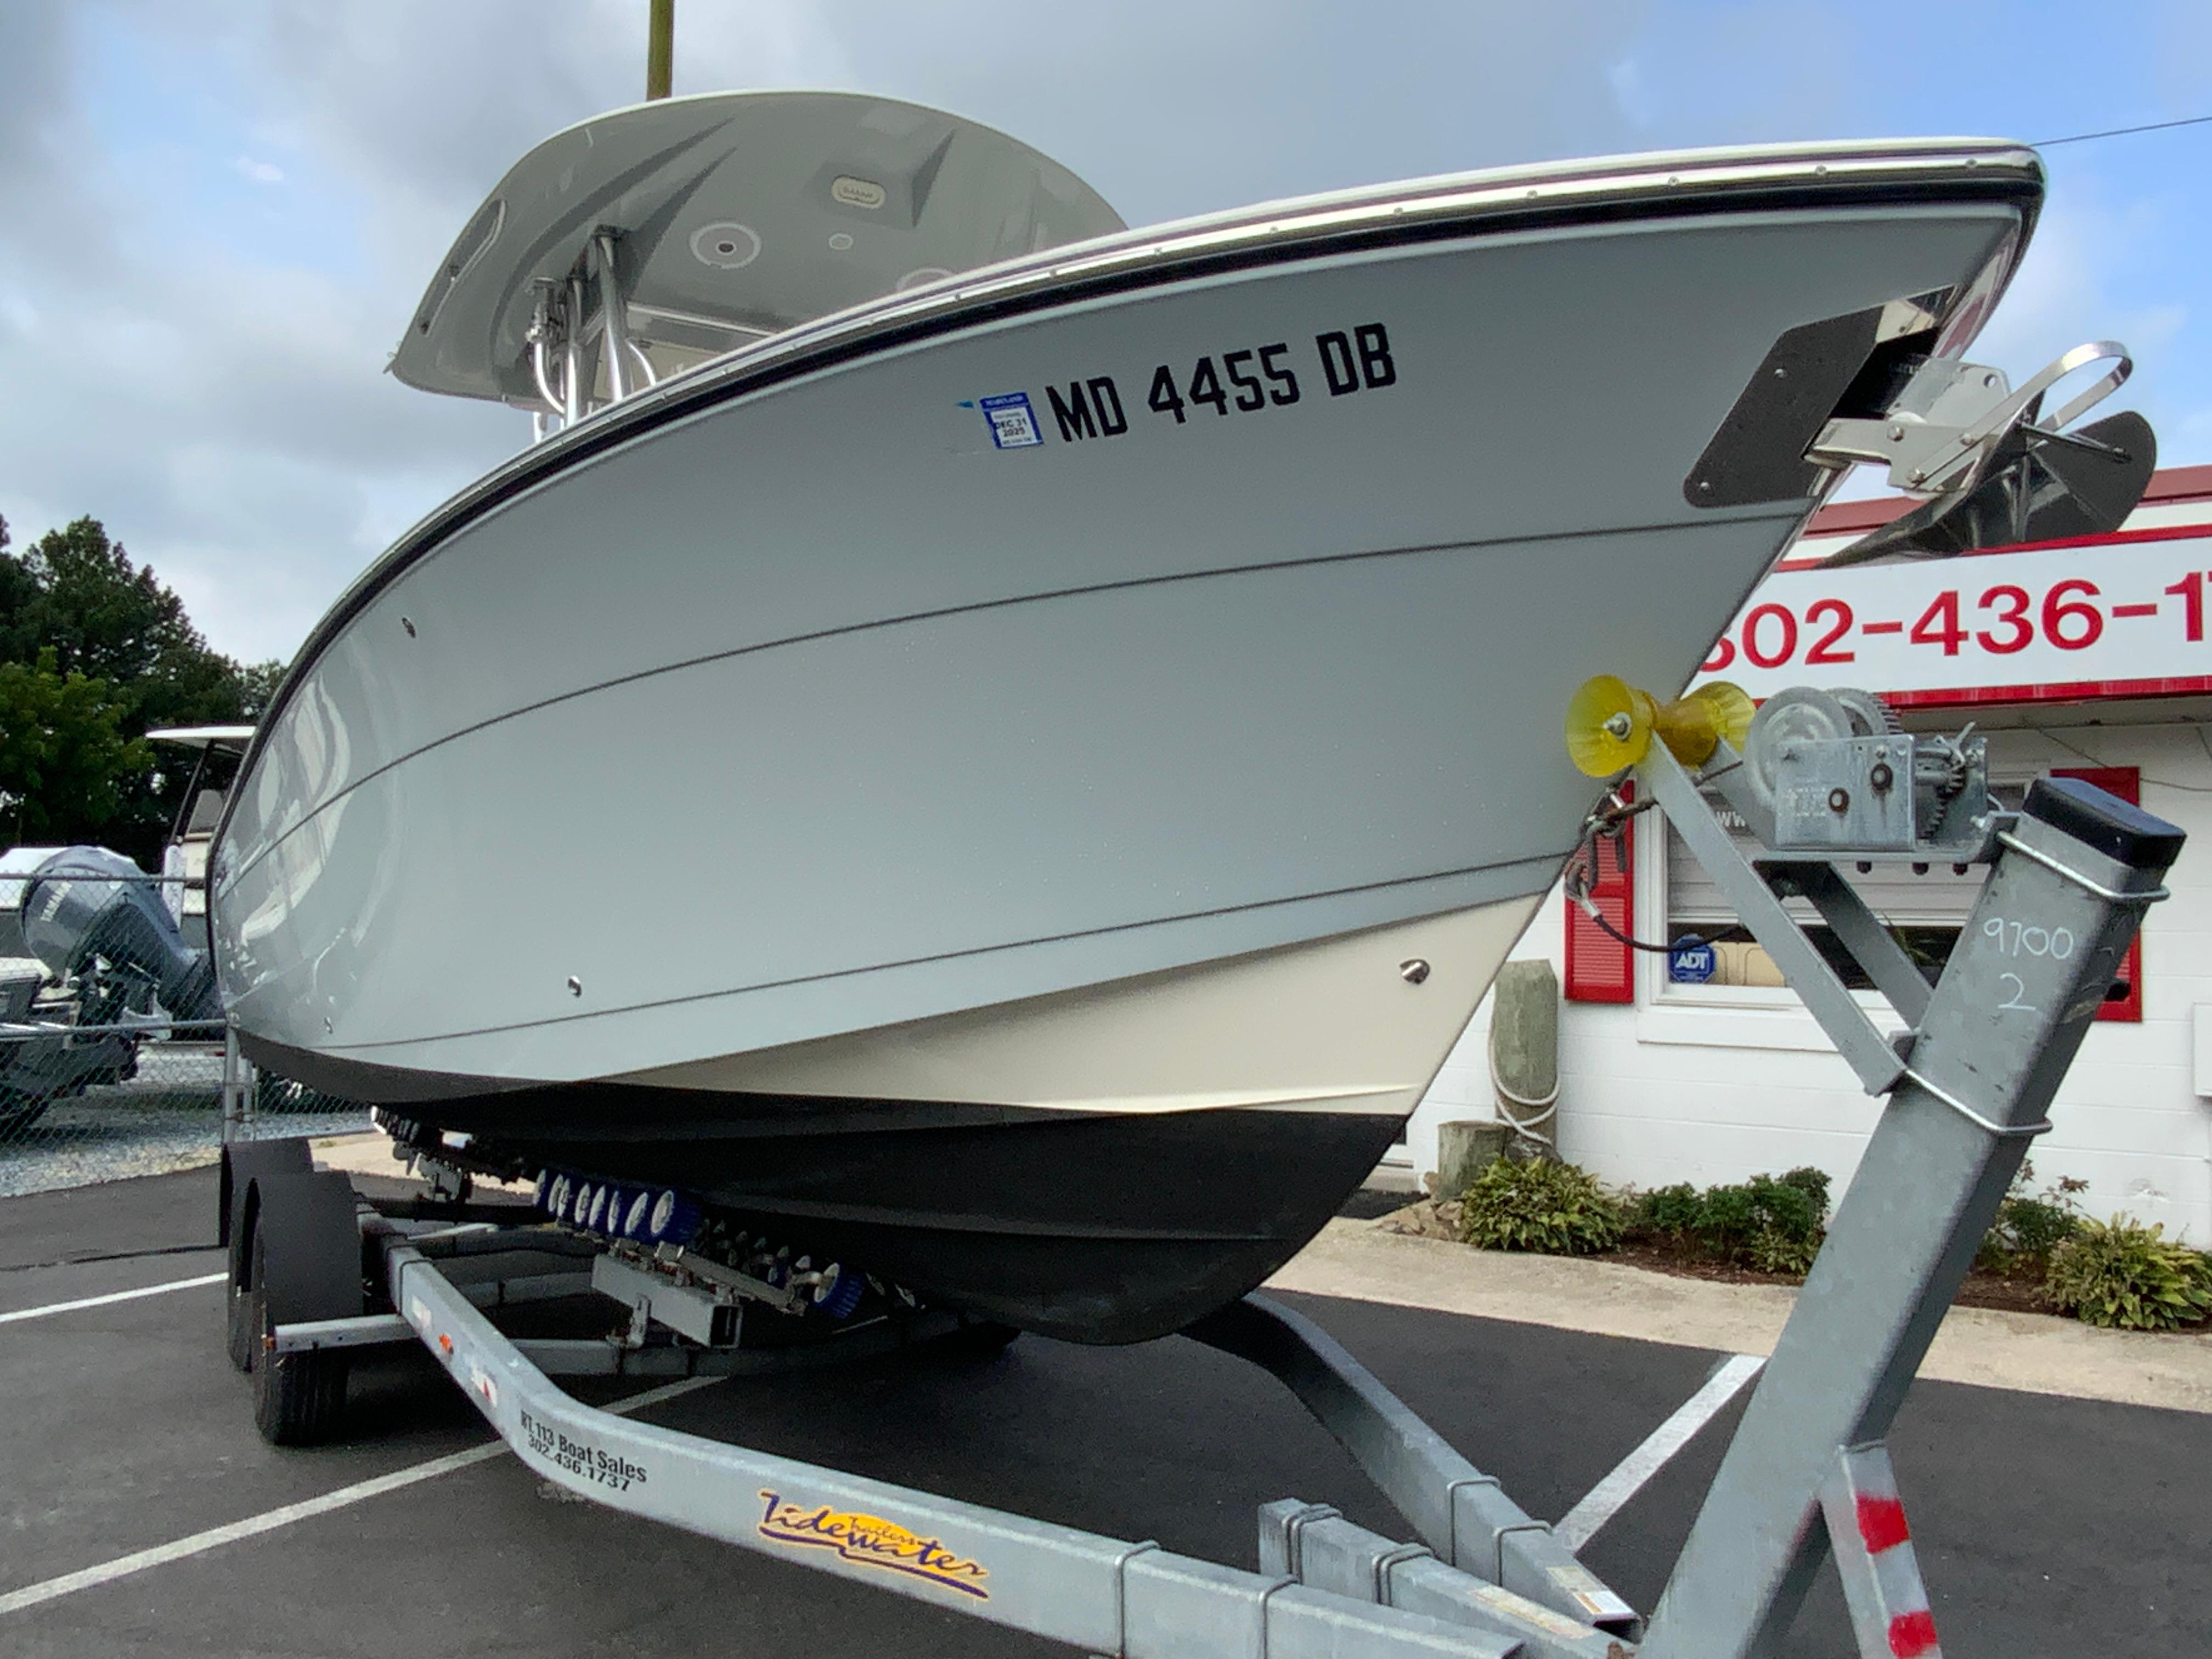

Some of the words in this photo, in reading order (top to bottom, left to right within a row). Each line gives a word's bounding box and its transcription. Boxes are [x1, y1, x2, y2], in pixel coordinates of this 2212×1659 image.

[1046, 376, 1127, 442] MD
[1148, 343, 1300, 424] 4455
[1316, 323, 1396, 396] DB
[995, 420, 1014, 430] DEC
[1017, 417, 1027, 426] 31
[1699, 571, 2212, 673] 02-436-1
[1675, 952, 1709, 969] ADT
[1983, 917, 2074, 959] 9700
[1997, 972, 2036, 1011] 2
[528, 1433, 630, 1492] 302.436.1737
[536, 1422, 555, 1447] 113
[558, 1433, 593, 1465] Boat
[596, 1449, 647, 1483] Sales
[760, 1491, 987, 1576] Tidewater
